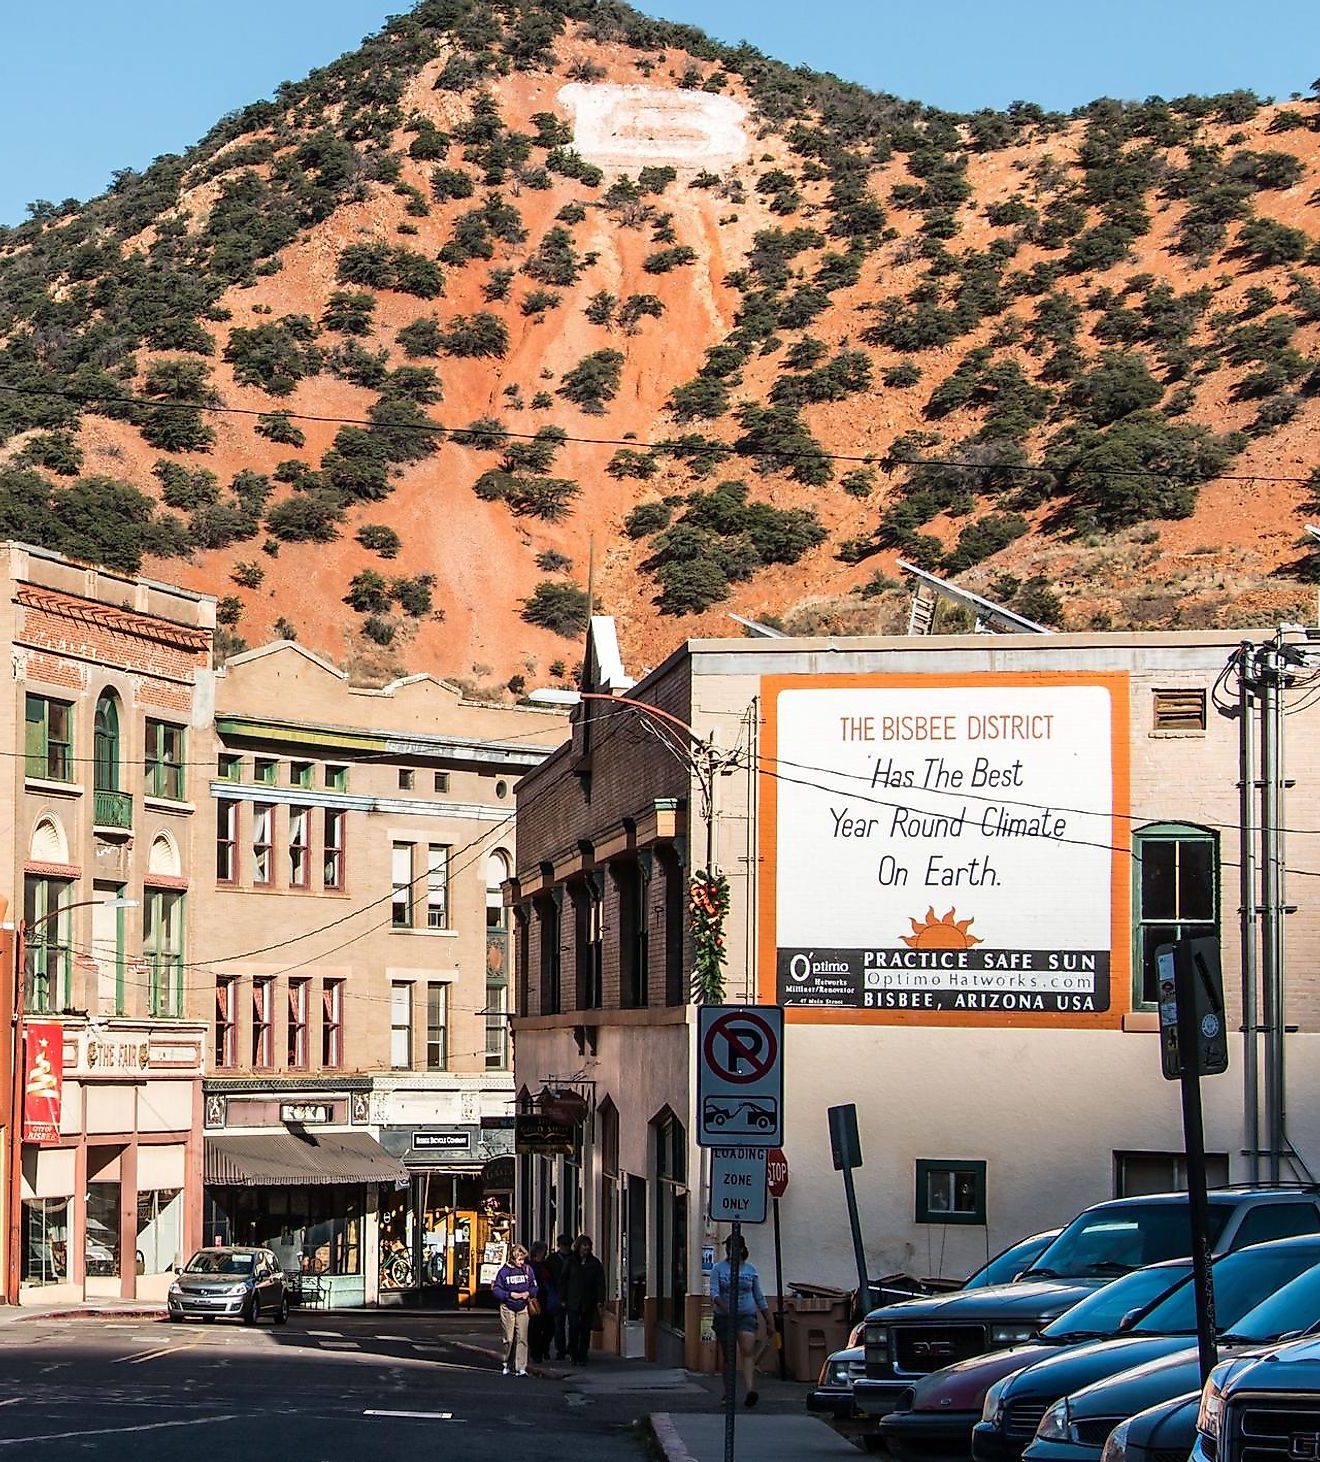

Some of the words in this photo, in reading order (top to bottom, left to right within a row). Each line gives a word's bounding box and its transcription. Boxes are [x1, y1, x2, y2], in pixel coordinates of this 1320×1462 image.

[840, 717, 875, 741] THE
[883, 716, 956, 740] BISBEE
[968, 715, 1054, 740] DISTRICT
[871, 758, 914, 788] Has
[924, 758, 963, 788] The
[971, 757, 1024, 787] Best
[830, 807, 879, 838] Year
[890, 807, 966, 838] Round
[982, 806, 1066, 838] Climate
[879, 855, 908, 886] On
[925, 855, 1001, 886] Earth.
[864, 952, 968, 968] PRACTICE
[984, 953, 1032, 969] SAFE
[1048, 954, 1096, 970] SUN
[867, 972, 941, 989] Optimo
[949, 973, 1092, 989] Hatworks.com
[864, 992, 942, 1012] BISBEE,
[954, 994, 1045, 1010] ARIZONA
[1057, 996, 1095, 1011] USA
[98, 1044, 115, 1067] THE
[118, 1044, 137, 1067] FAIR
[728, 1028, 763, 1072] P
[27, 1132, 57, 1140] BISBEE
[32, 1125, 44, 1133] CITY
[714, 1149, 764, 1160] LOADING
[724, 1174, 752, 1186] ZONE
[768, 1163, 786, 1181] STOP
[723, 1198, 749, 1209] ONLY
